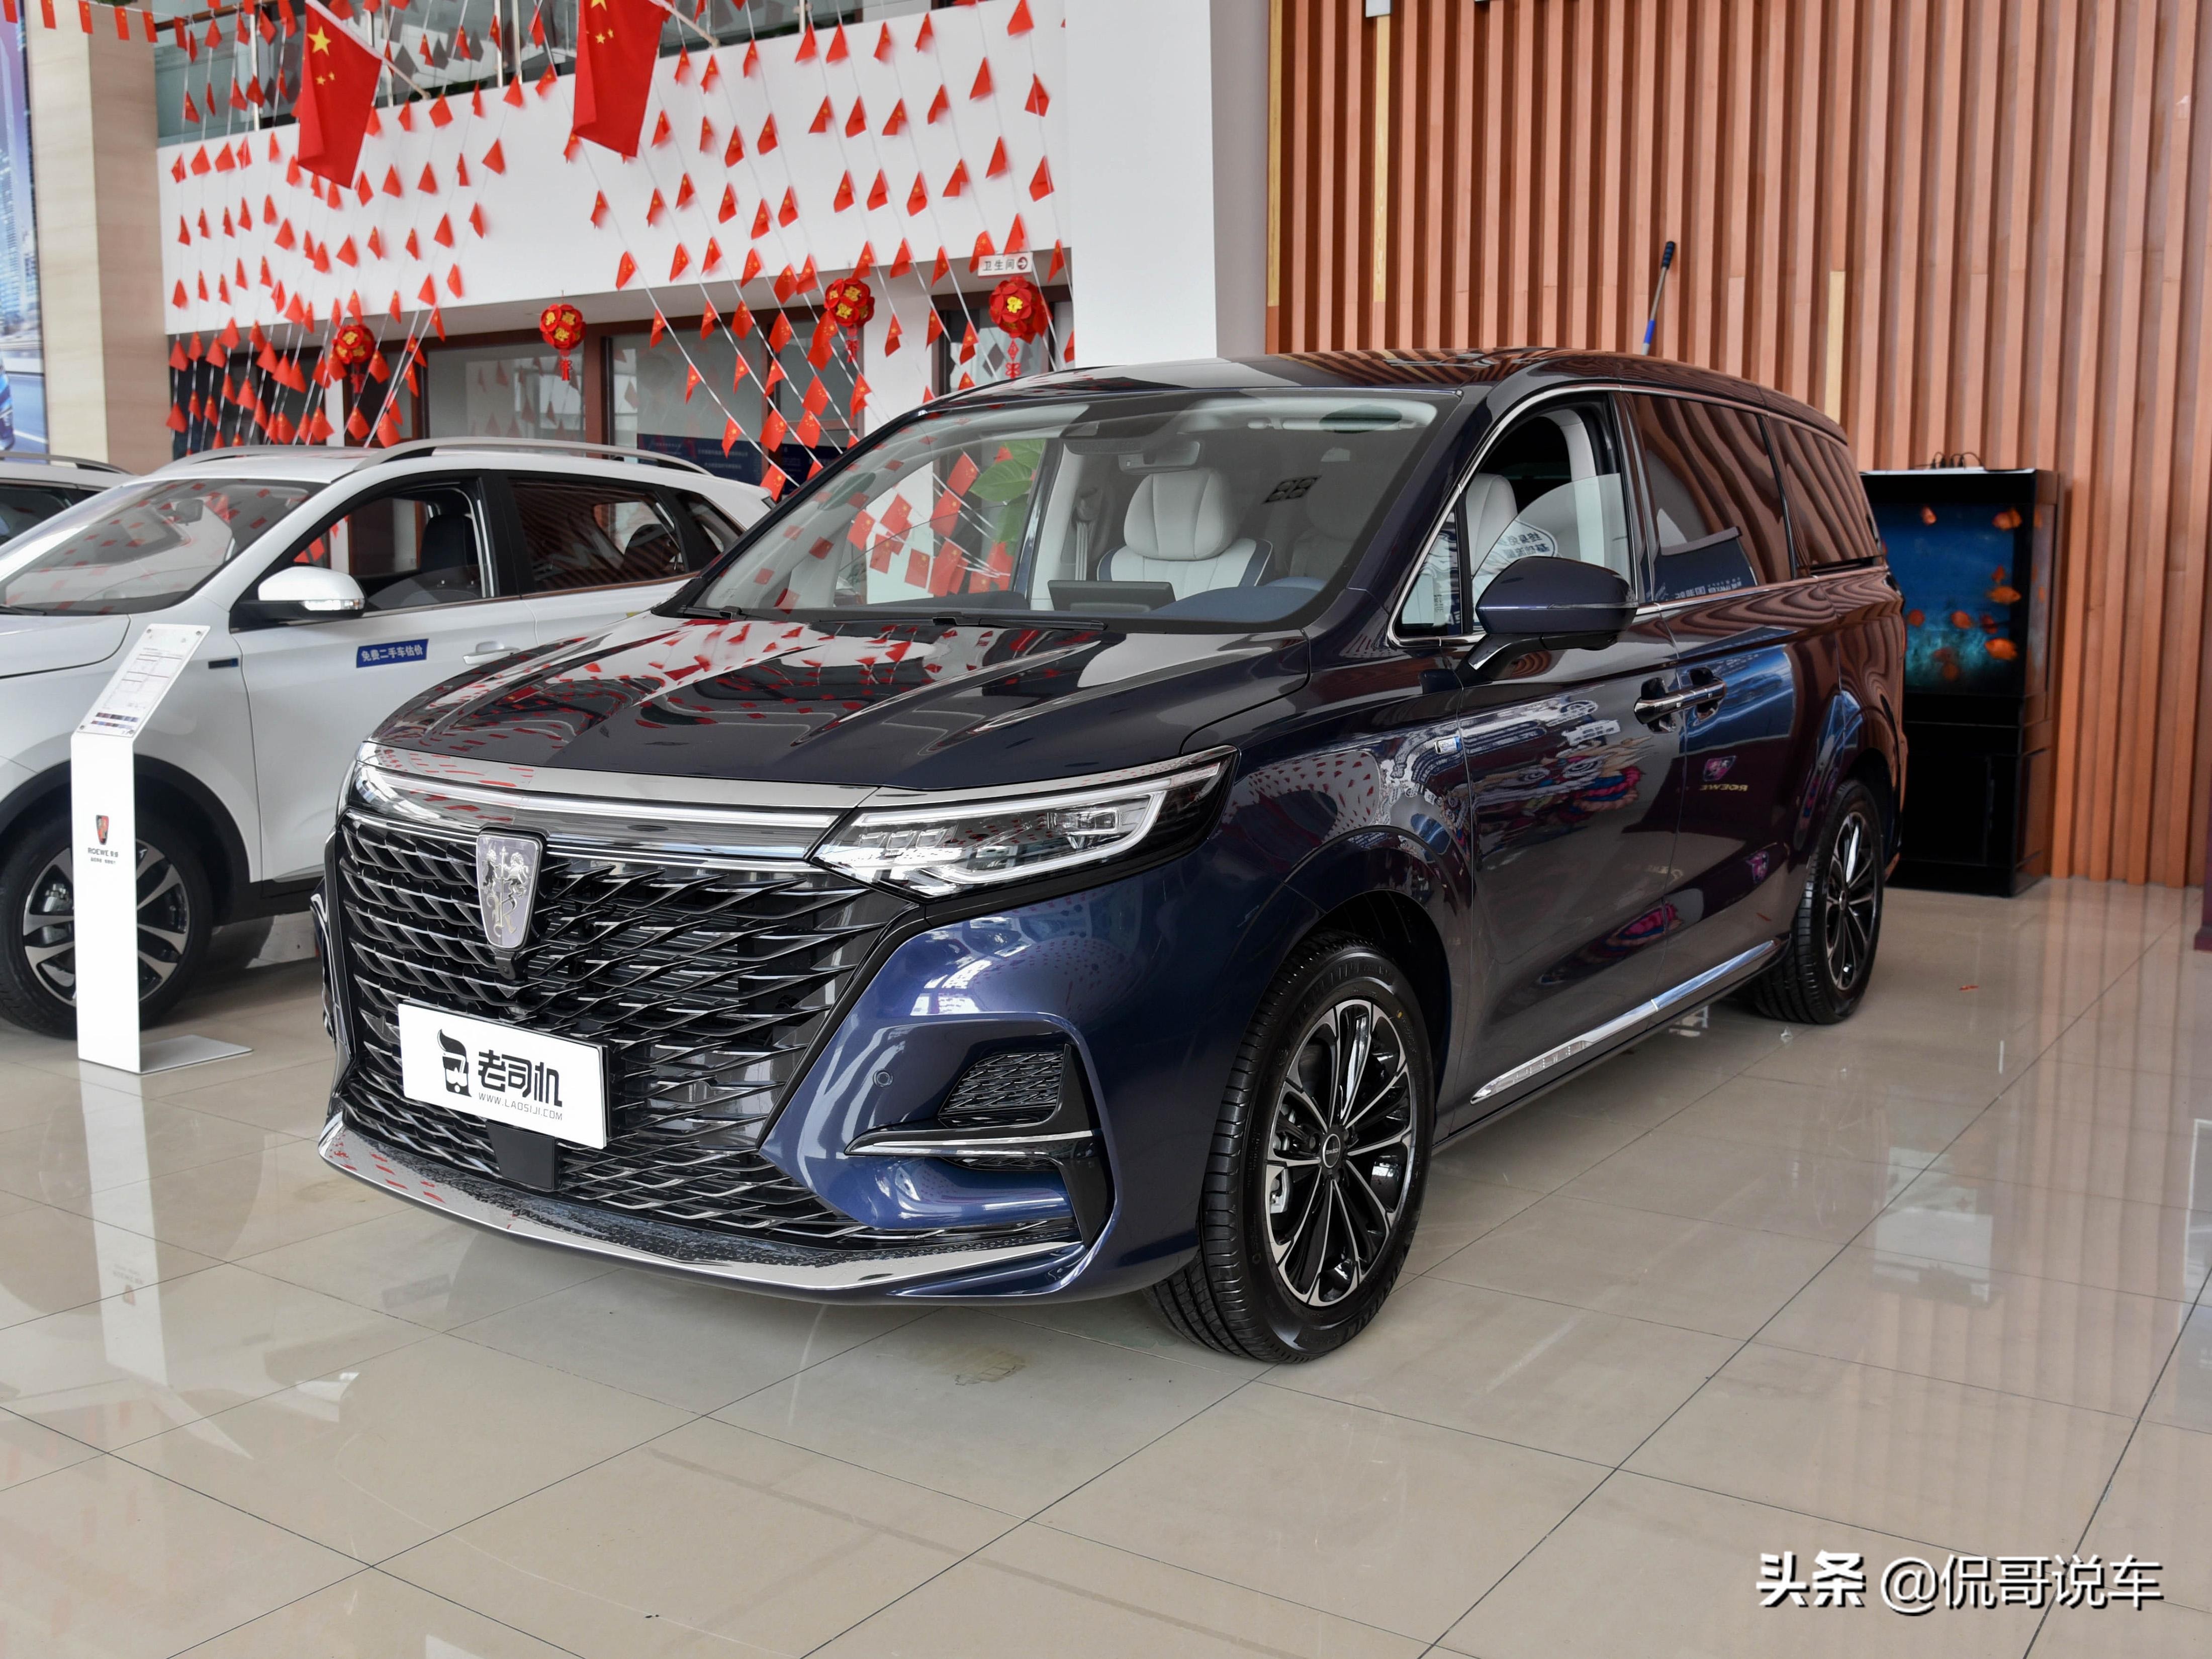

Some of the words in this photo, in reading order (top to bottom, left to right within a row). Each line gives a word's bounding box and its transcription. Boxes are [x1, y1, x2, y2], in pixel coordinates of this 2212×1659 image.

[982, 259, 1015, 271] 卫生间
[361, 644, 423, 662] 免费二手车估价
[87, 848, 109, 856] ROEWE
[478, 1049, 563, 1107] 老司机
[479, 1092, 563, 1121] WWW.LAOSIJI.COM
